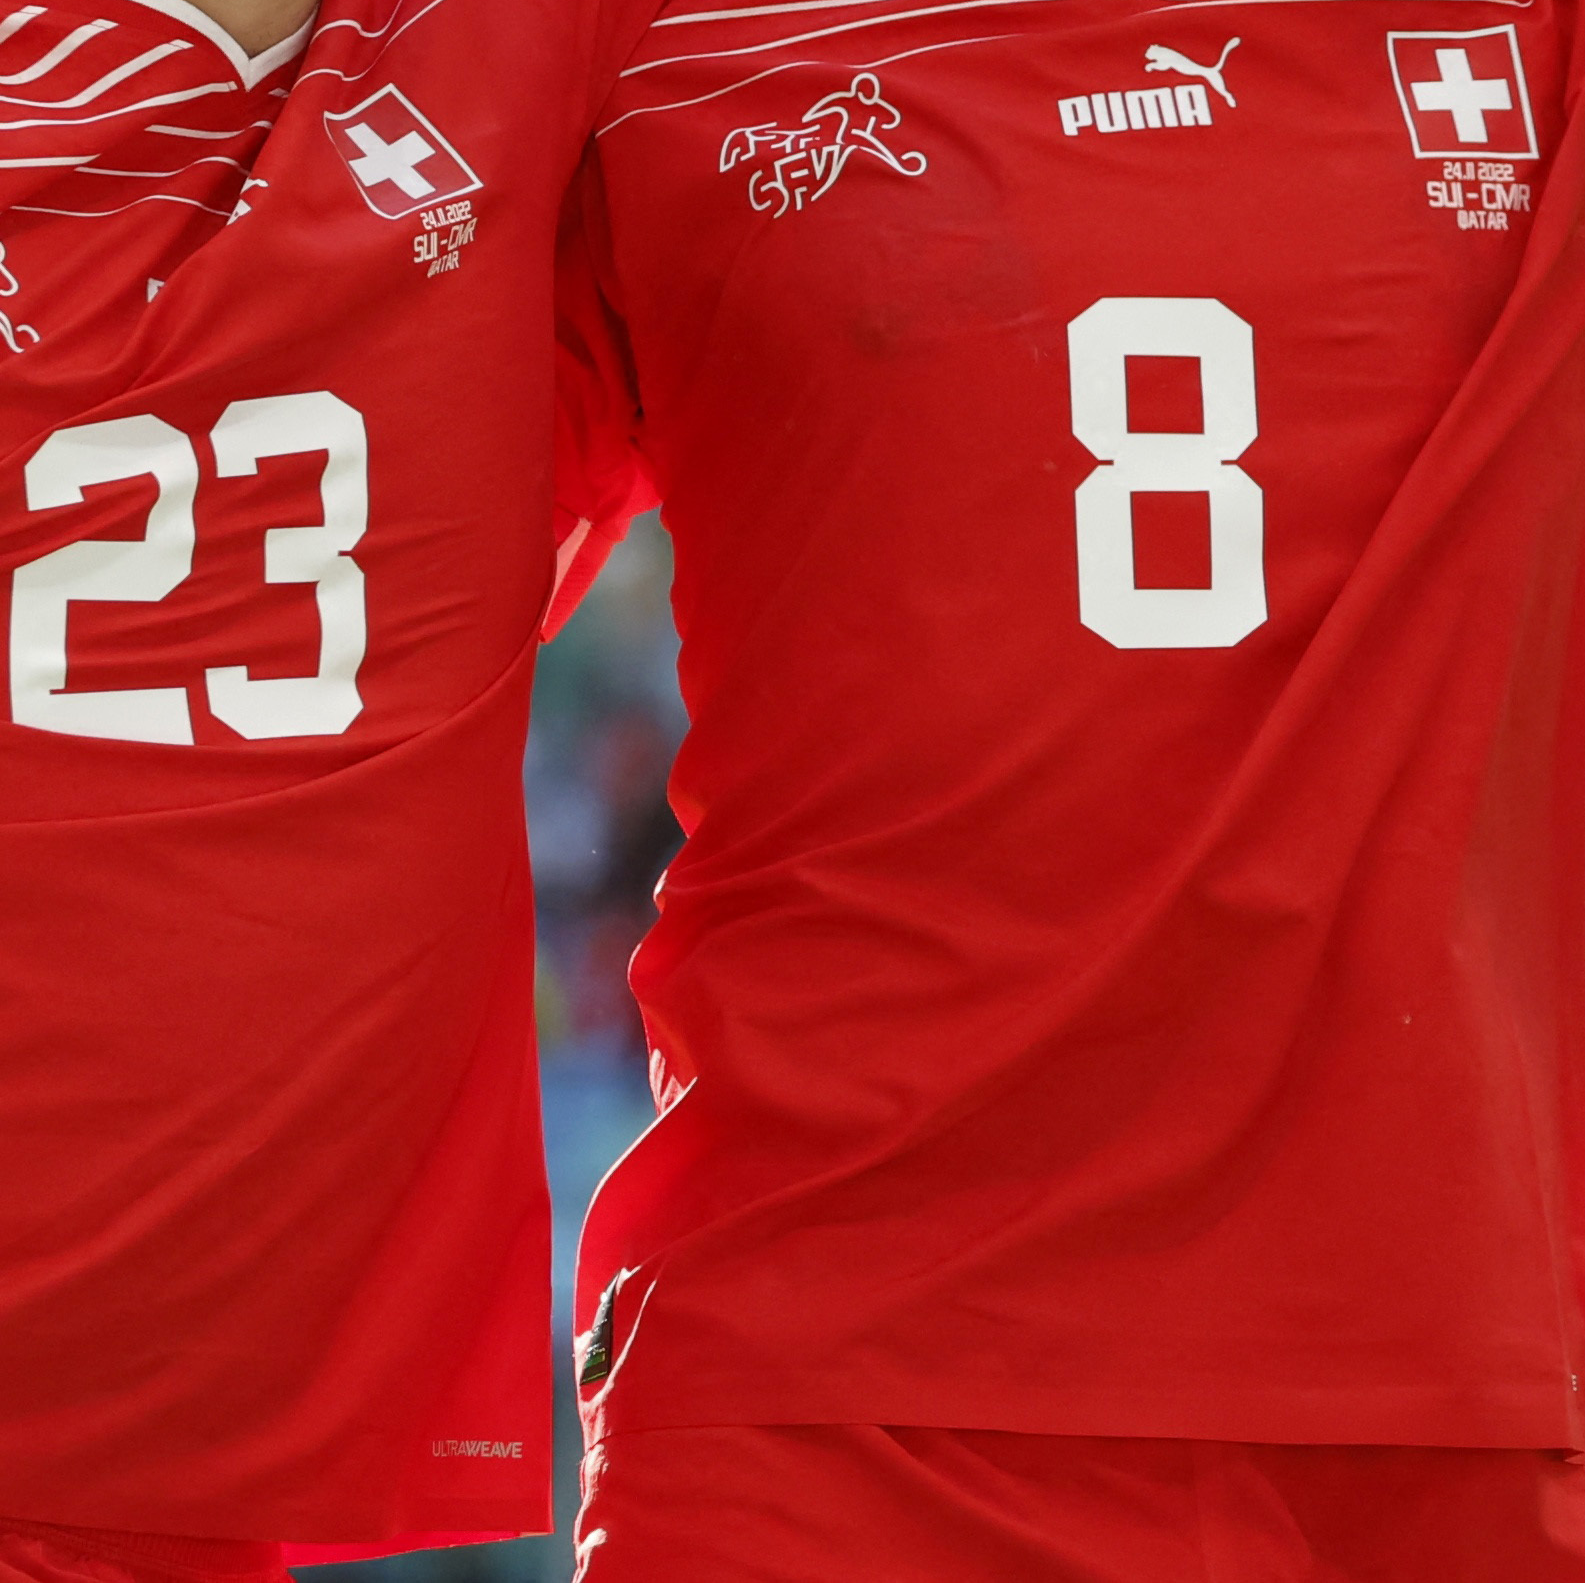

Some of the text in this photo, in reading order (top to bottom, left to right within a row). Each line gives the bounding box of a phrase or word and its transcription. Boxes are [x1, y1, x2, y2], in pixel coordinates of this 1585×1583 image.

[1058, 84, 1213, 136] PUMA
[1457, 210, 1509, 231] QATAR
[1066, 297, 1268, 649] 8
[8, 390, 370, 746] 23
[432, 1439, 523, 1459] ULTRAWEAVE
